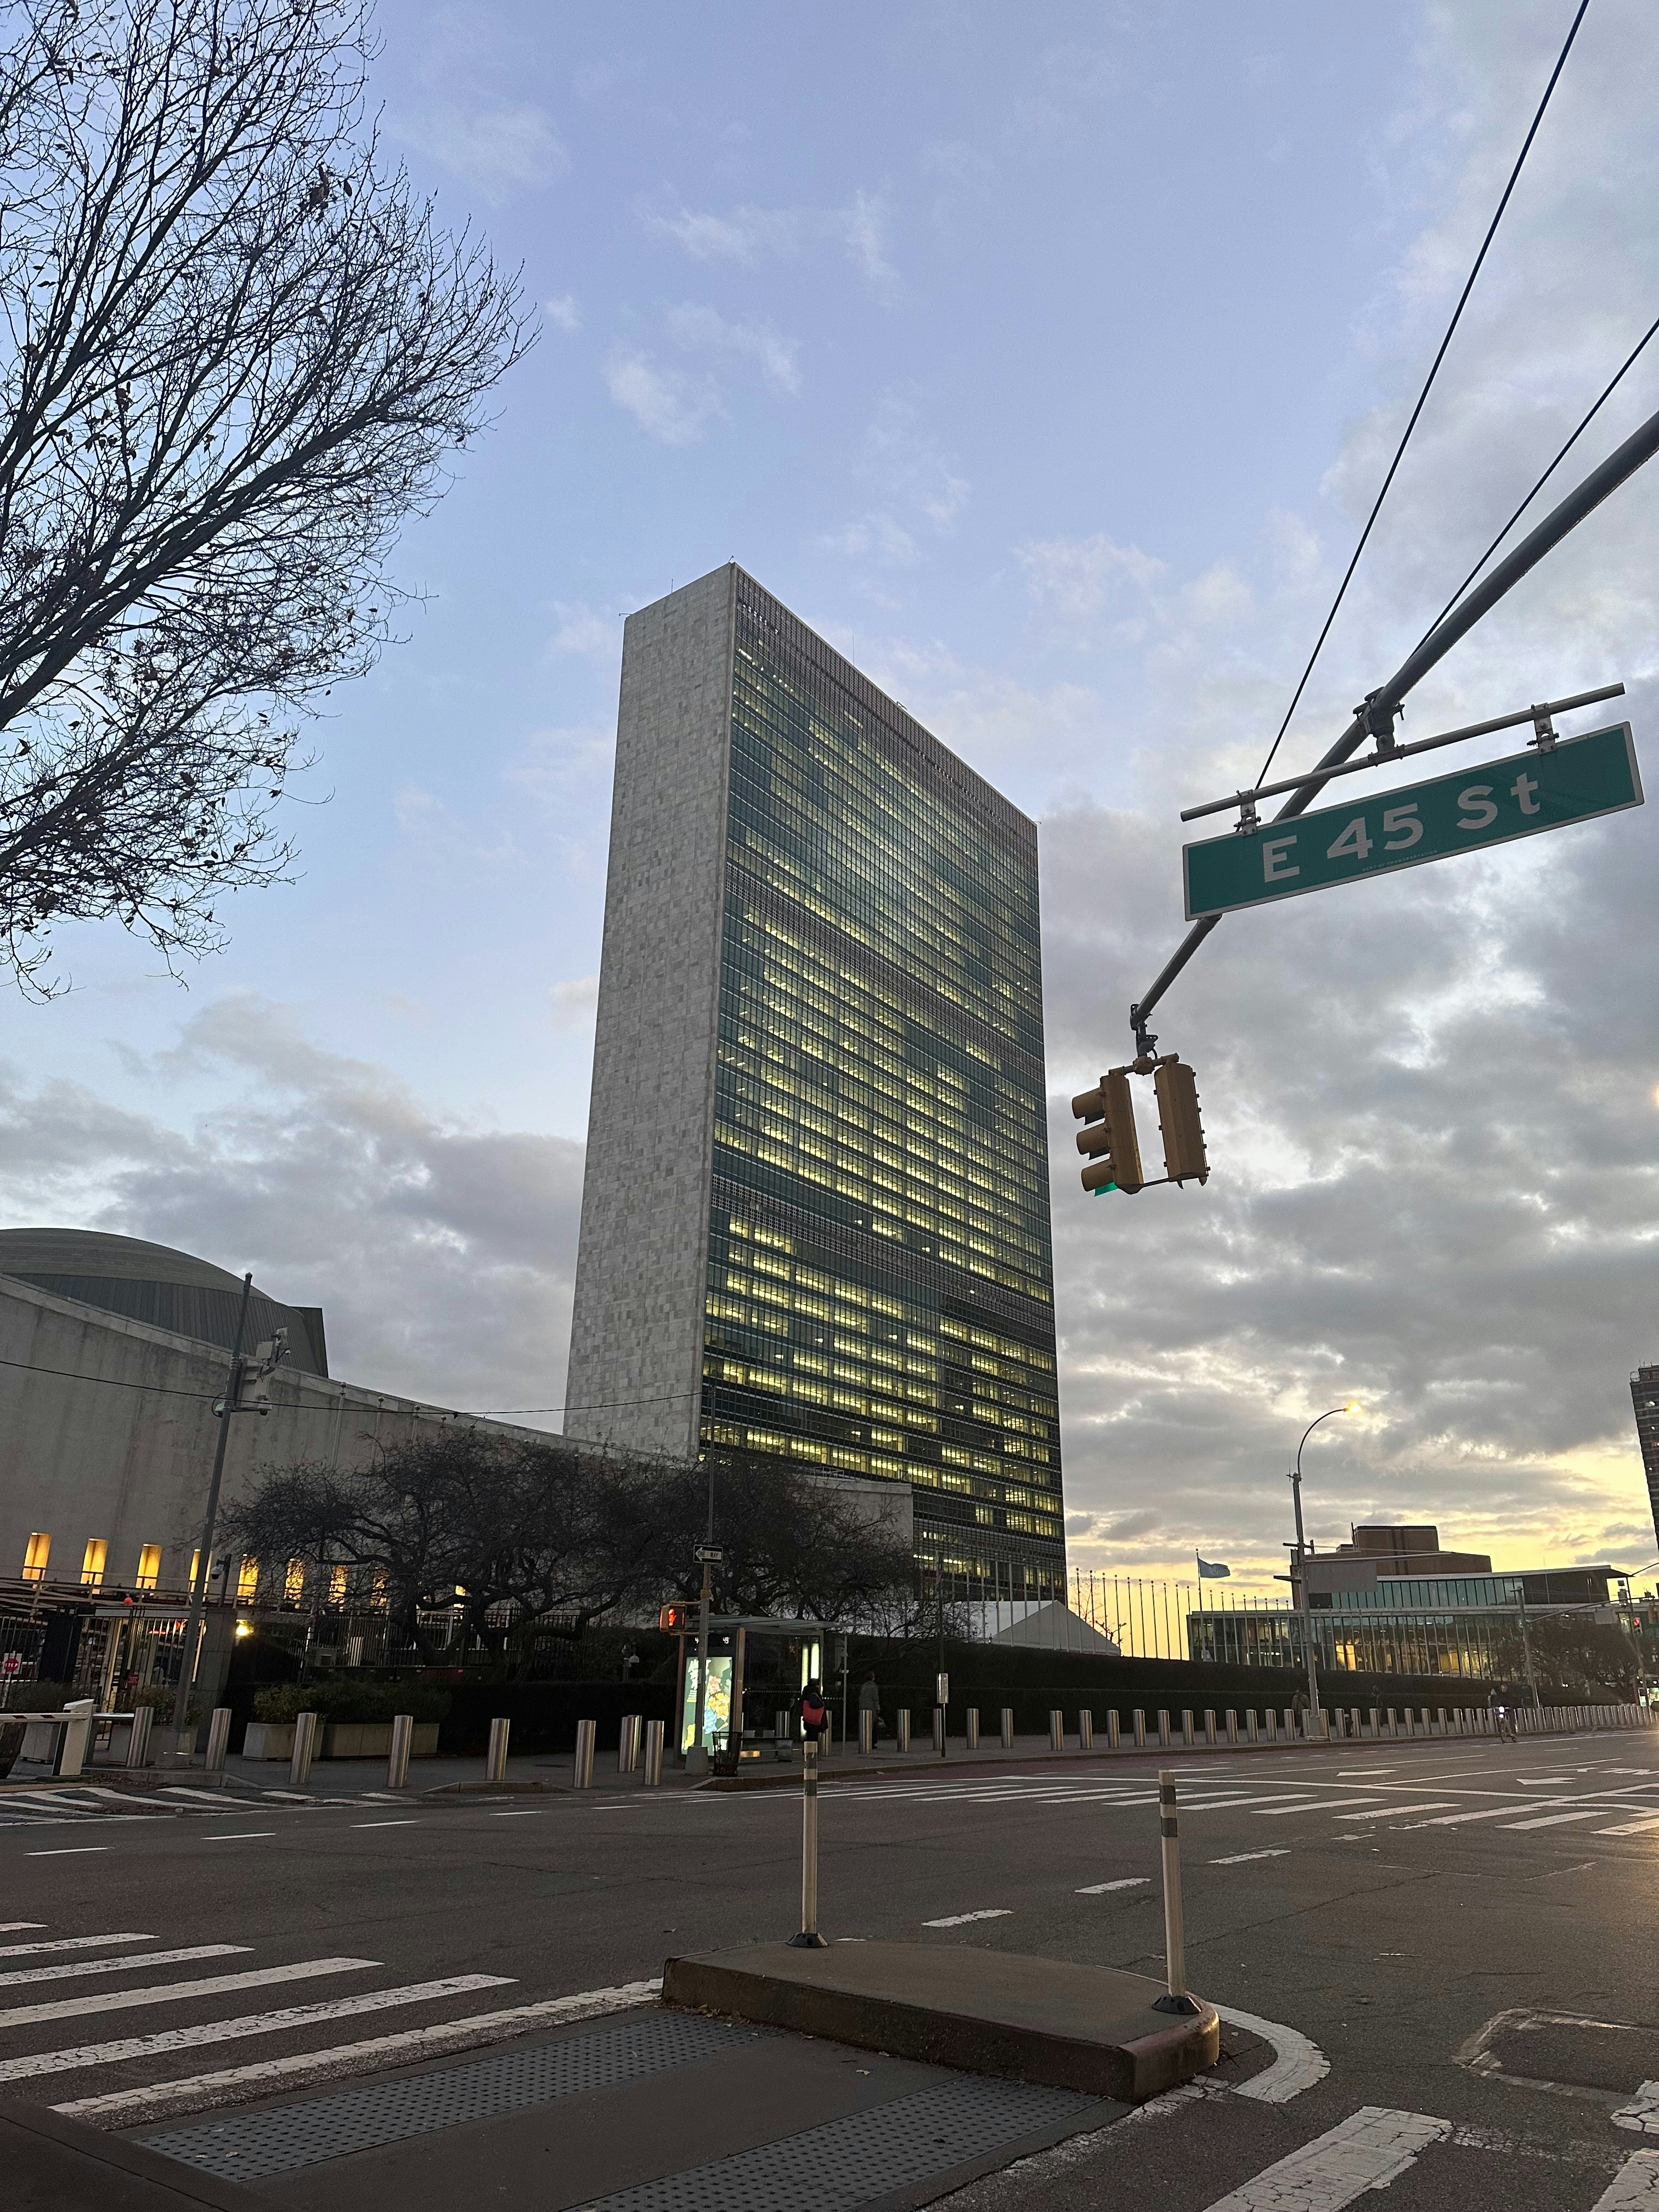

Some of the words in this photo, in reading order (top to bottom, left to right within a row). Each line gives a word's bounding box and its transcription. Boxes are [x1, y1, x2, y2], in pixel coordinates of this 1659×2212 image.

[1262, 835, 1300, 883] E
[1327, 803, 1424, 859] 45
[1457, 772, 1541, 830] St
